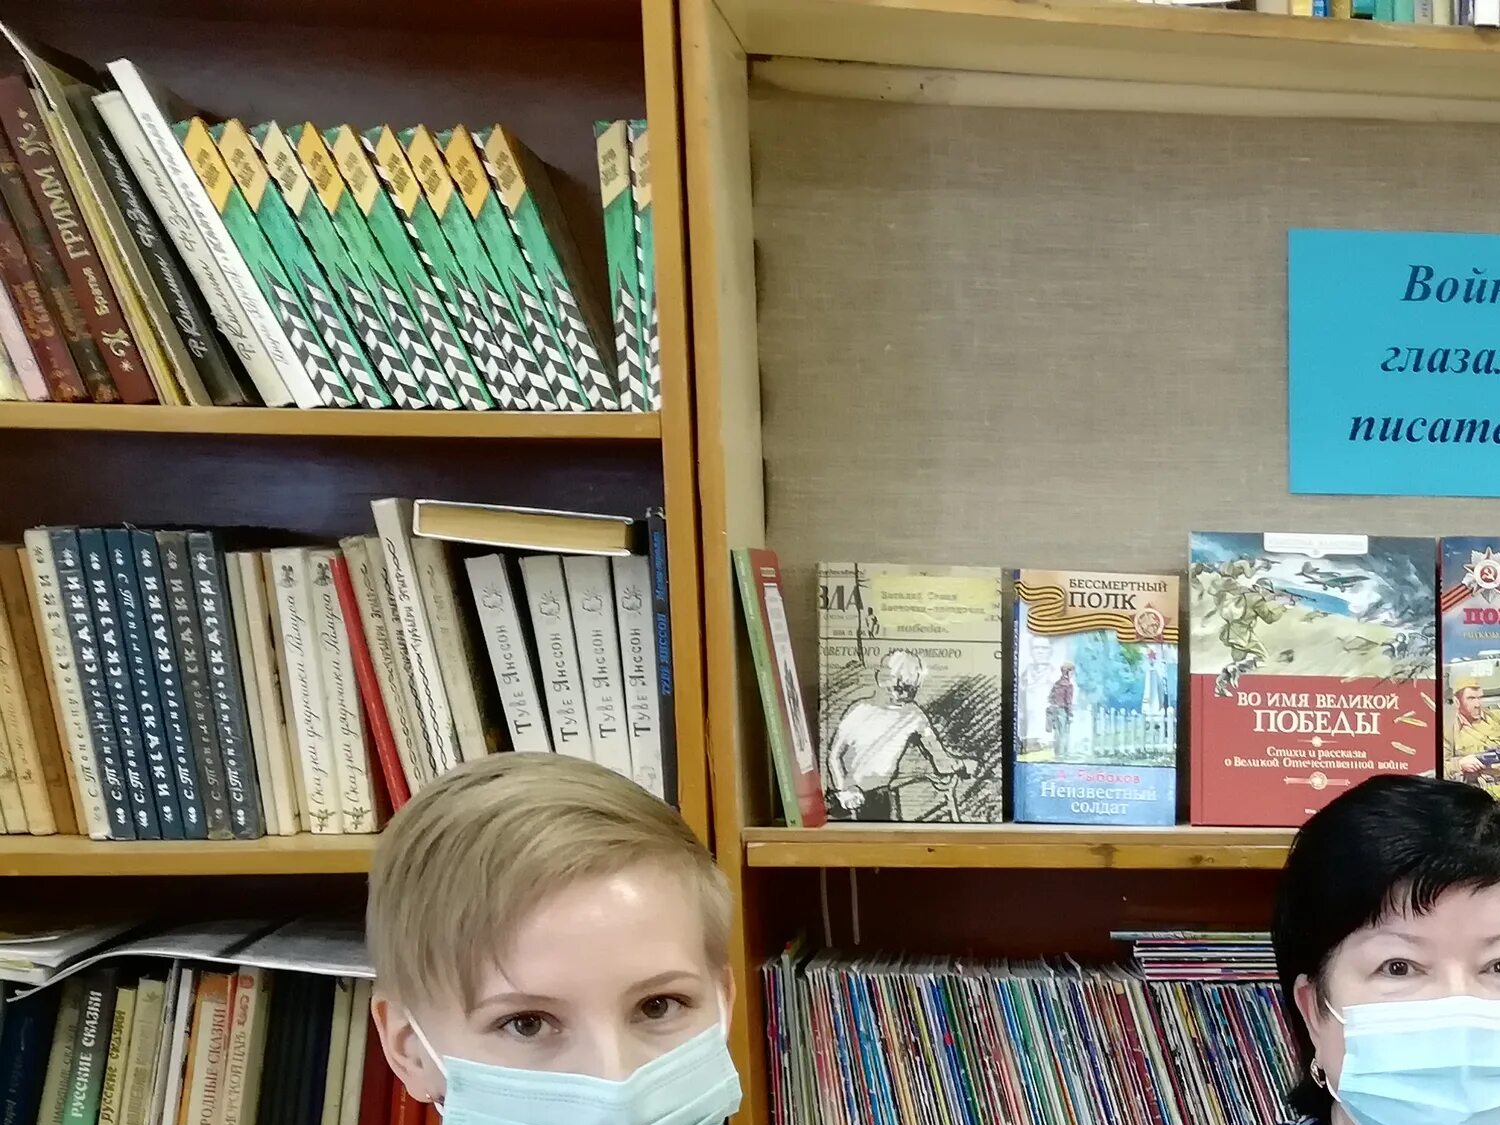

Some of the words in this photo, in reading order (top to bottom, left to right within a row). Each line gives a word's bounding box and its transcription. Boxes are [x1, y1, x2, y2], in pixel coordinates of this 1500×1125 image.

[33, 166, 90, 260] ГРИММ
[1069, 578, 1168, 593] БЕССМЕРТНЫЙ
[1069, 591, 1137, 611] ПОЛК
[63, 576, 98, 674] СКАЗКИ
[91, 579, 122, 677] СКАЗКИ
[143, 575, 174, 674] СКАЗКИ
[169, 578, 200, 675] СКАЗКИ
[198, 579, 227, 677] СКАЗКИ
[1237, 692, 1262, 707] ВО
[1266, 692, 1310, 709] ИМЯ
[1316, 692, 1400, 711] ВЕЛИКОЙ
[1253, 710, 1382, 737] ПОБЕДЫ
[141, 702, 171, 798] СКАЗКИ
[304, 741, 327, 808] Сказки
[340, 739, 364, 805] Сказки
[1224, 759, 1232, 767] о
[1234, 756, 1280, 769] Великой
[1282, 758, 1375, 771] Отечественной
[1378, 760, 1409, 771] войне
[1266, 746, 1307, 759] Стихи
[1308, 749, 1316, 758] и
[1317, 750, 1367, 761] рассказы
[1041, 781, 1157, 801] Неизвестный
[1071, 800, 1129, 816] солдат
[70, 1052, 93, 1119] РУССКИЕ
[82, 990, 103, 1049] СКАЗКИ
[109, 1009, 127, 1061] сказки
[206, 1003, 227, 1067] СКАЗКИ
[101, 1065, 118, 1123] русские
